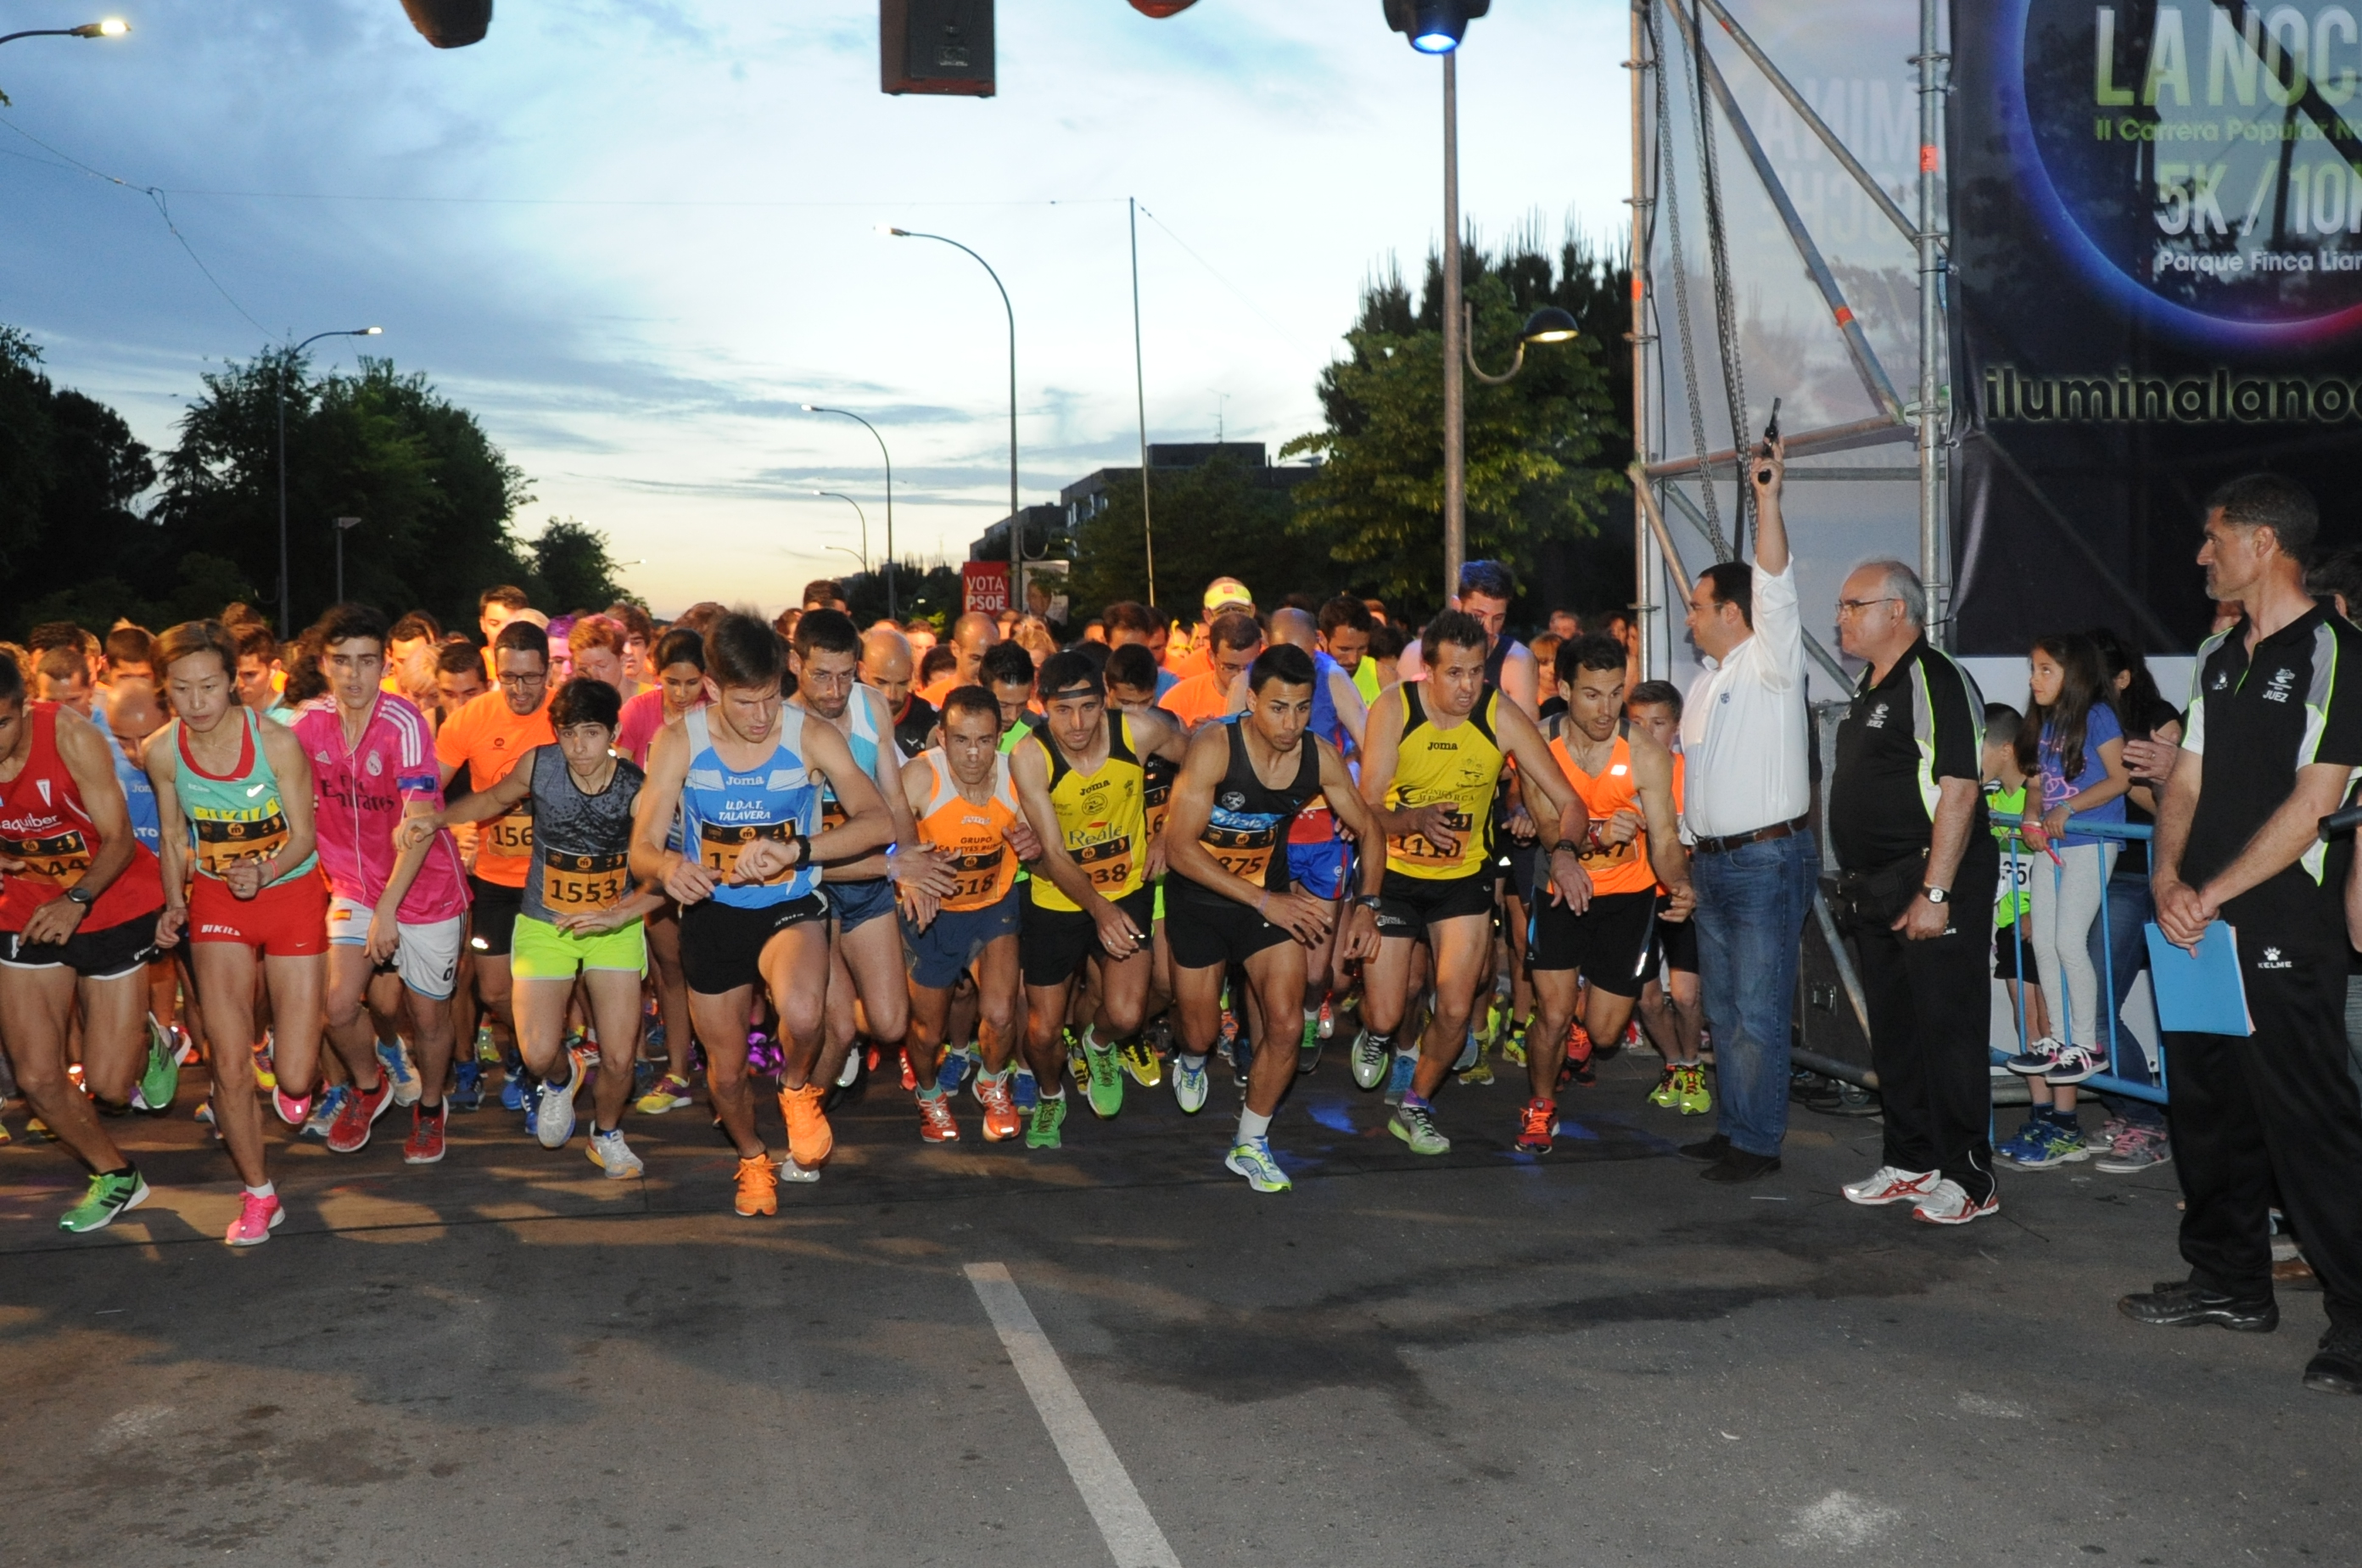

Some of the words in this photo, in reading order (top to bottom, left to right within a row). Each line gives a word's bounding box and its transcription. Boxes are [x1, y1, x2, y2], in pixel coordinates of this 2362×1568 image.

[2120, 118, 2219, 142] Carrera
[2227, 116, 2328, 145] Popular
[2155, 165, 2229, 235] 5K
[2160, 250, 2244, 276] Parque
[2251, 251, 2314, 272] Finca
[966, 576, 1005, 591] VOTA
[966, 596, 1005, 610] PSOE
[2263, 690, 2289, 703] JUEZ
[719, 811, 771, 821] TALAVERA
[1069, 821, 1123, 848] Reale
[551, 878, 618, 903] 1553
[2257, 960, 2292, 969] KELME
